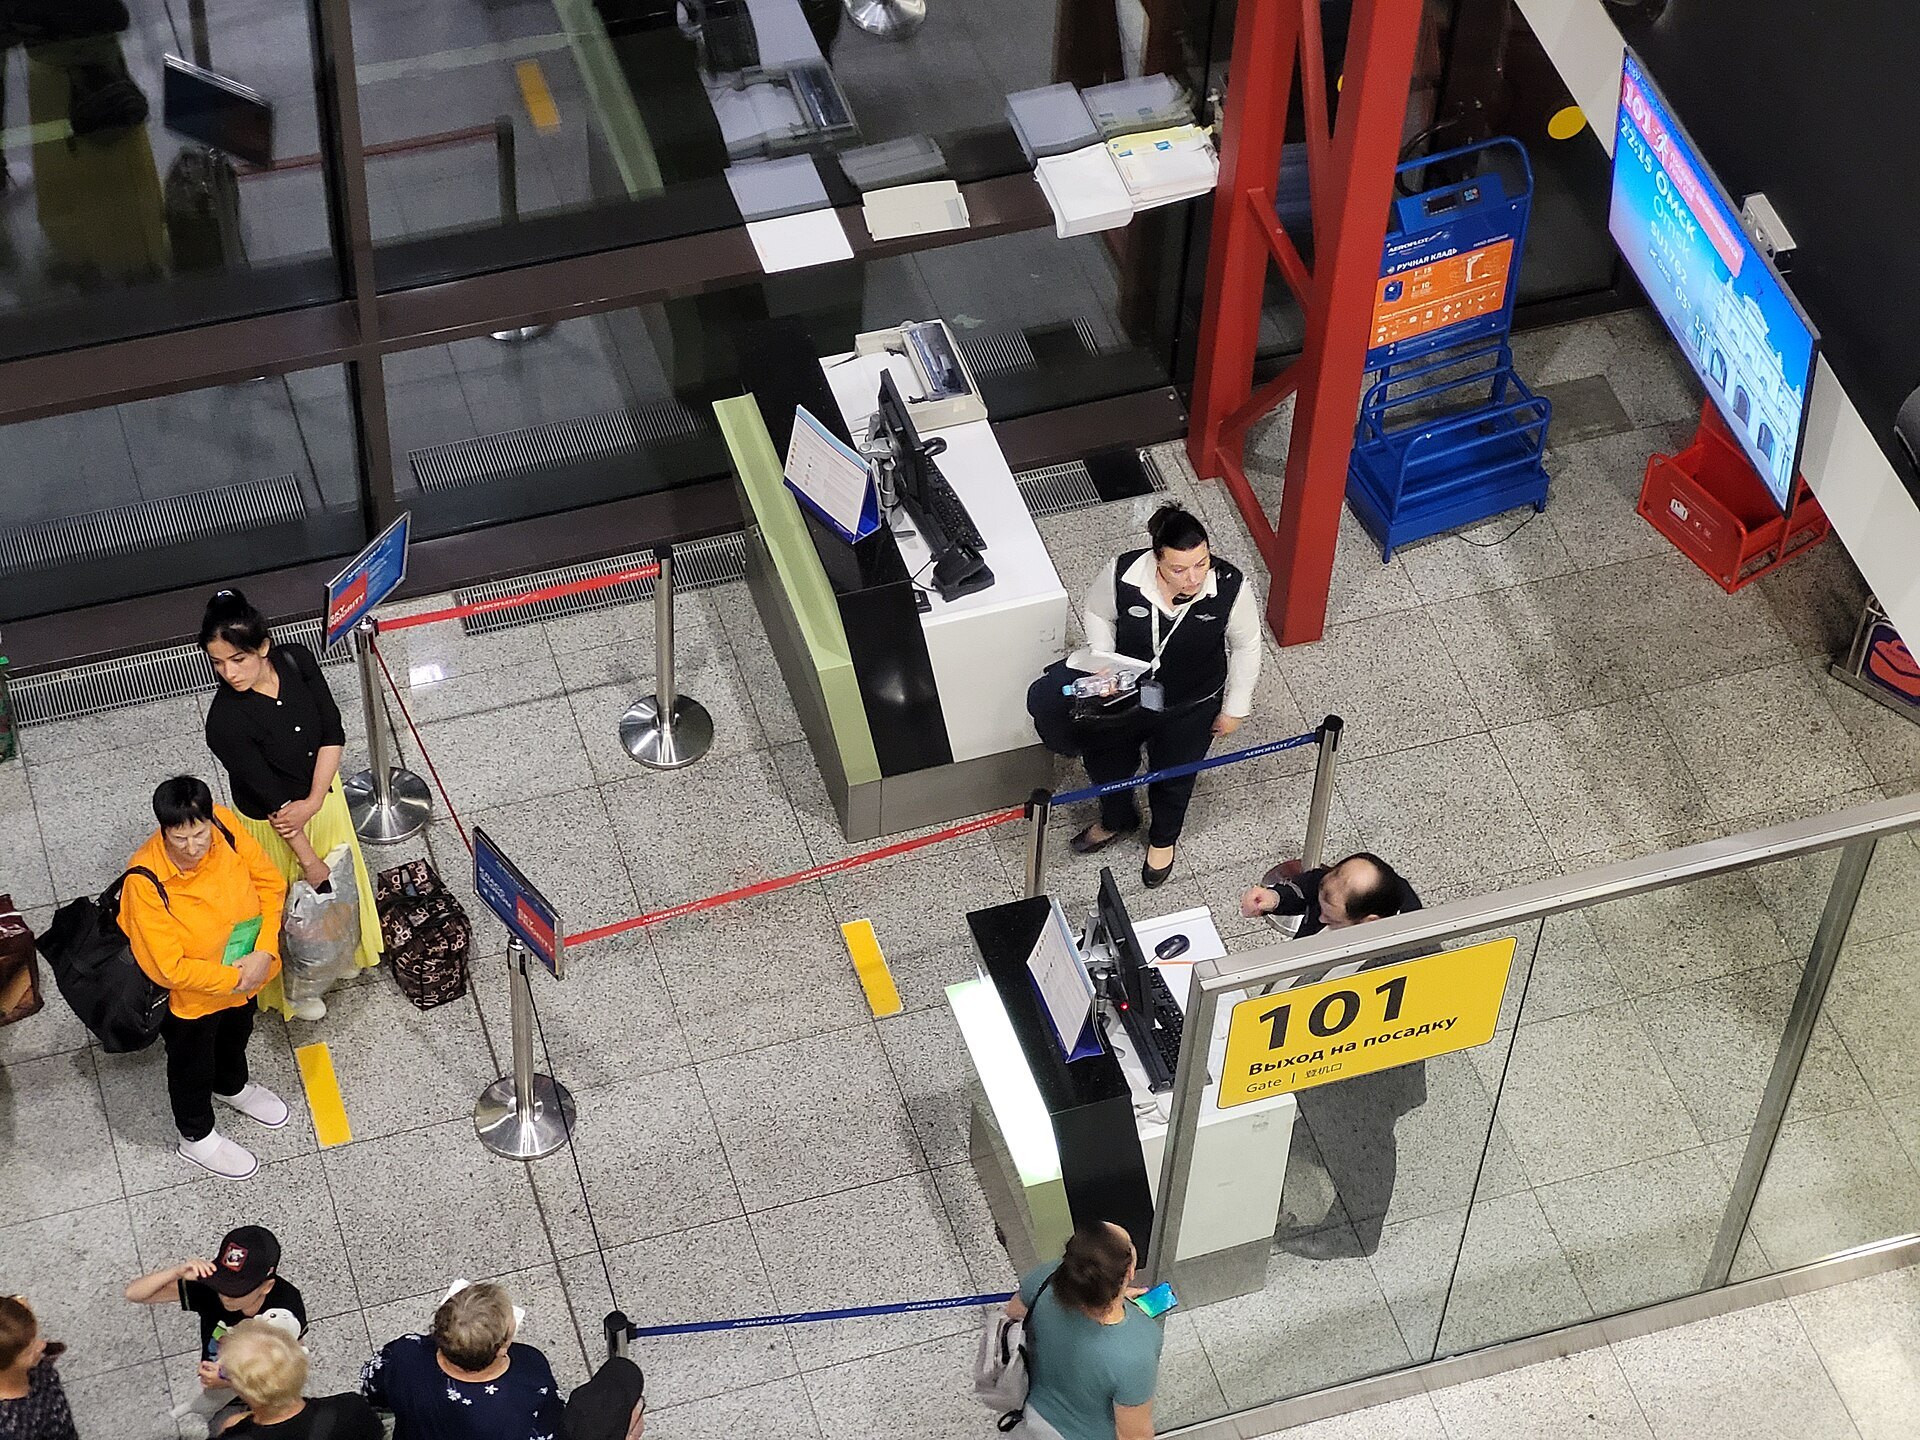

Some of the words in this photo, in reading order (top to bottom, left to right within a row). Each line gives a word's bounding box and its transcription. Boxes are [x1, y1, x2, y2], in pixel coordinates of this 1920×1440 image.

[1624, 82, 1652, 135] 101
[1620, 116, 1653, 173] 22:15
[1653, 195, 1690, 260] Omsk
[1388, 236, 1430, 254] AEROFLOT
[1650, 220, 1688, 286] SU1762
[1396, 255, 1430, 272] РУЧНАЯ
[1430, 247, 1458, 262] КЛАДЬ
[330, 604, 346, 620] SKY
[473, 598, 517, 612] AEROFLOT
[1244, 742, 1289, 758] AEROFLOT
[1100, 777, 1145, 792] AEROFLOT
[953, 818, 1000, 836] AEROFLOT
[799, 863, 846, 880] AEROFLOT
[1258, 975, 1408, 1051] 101
[1247, 1048, 1325, 1077] Выход
[1330, 1040, 1357, 1056] на
[1362, 1016, 1460, 1049] посадку
[1245, 1075, 1283, 1094] Gate
[1304, 1061, 1343, 1079] 登机口
[904, 1299, 958, 1311] AEROFLOT
[732, 1316, 786, 1328] AEROFLOT
